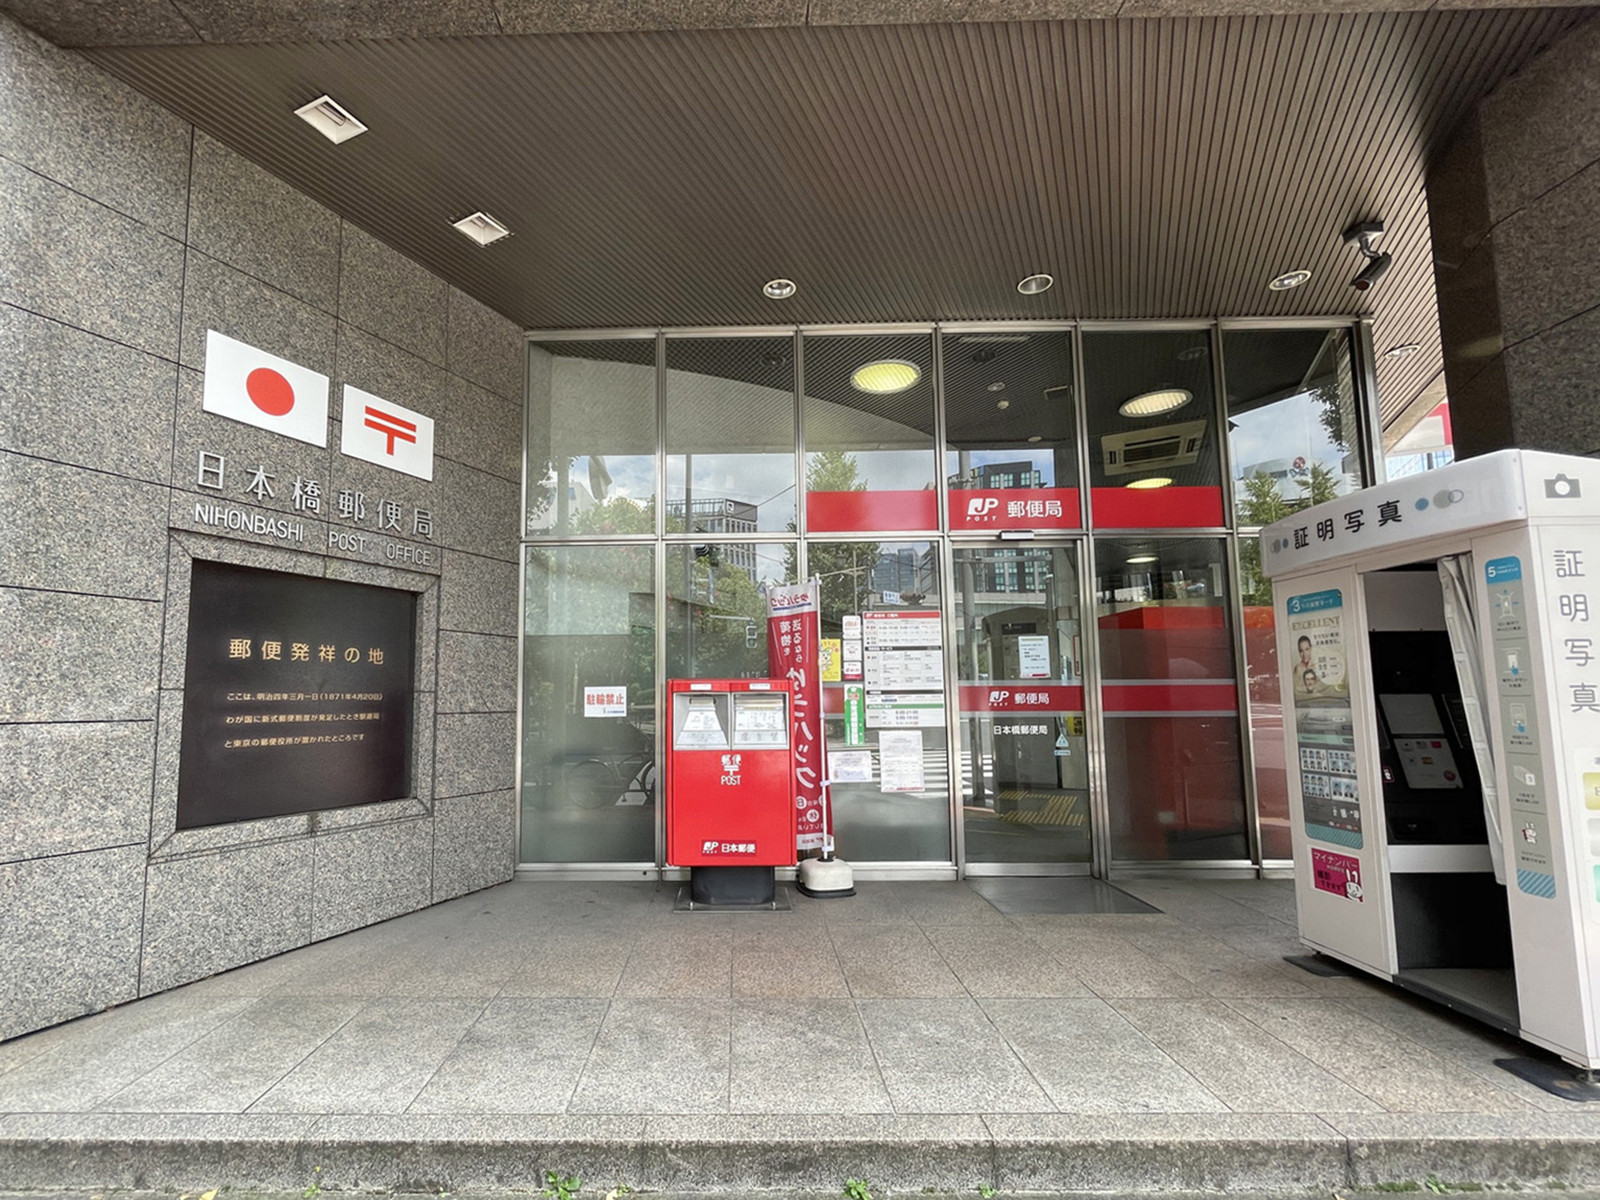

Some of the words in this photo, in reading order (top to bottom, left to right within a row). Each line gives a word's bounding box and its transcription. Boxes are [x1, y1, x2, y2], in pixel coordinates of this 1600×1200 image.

[198, 450, 433, 540] 日本橋郵便局
[967, 497, 999, 515] JP
[1007, 501, 1062, 518] 郵便局
[1294, 500, 1402, 549] 証明写真
[194, 502, 303, 542] NIHONBASHI
[328, 531, 366, 553] POST
[386, 543, 431, 566] OFFICE
[1292, 616, 1340, 631] EXCELLENT
[1553, 550, 1600, 712] 証明写真
[229, 638, 384, 665] 郵便発祥の地
[586, 693, 624, 705] 駐輪禁止
[1014, 692, 1050, 705] 郵便局
[993, 724, 1048, 735] 日本橋郵便局
[721, 754, 742, 766] 郵便
[721, 775, 741, 786] POST
[721, 843, 756, 853] 日本郵便
